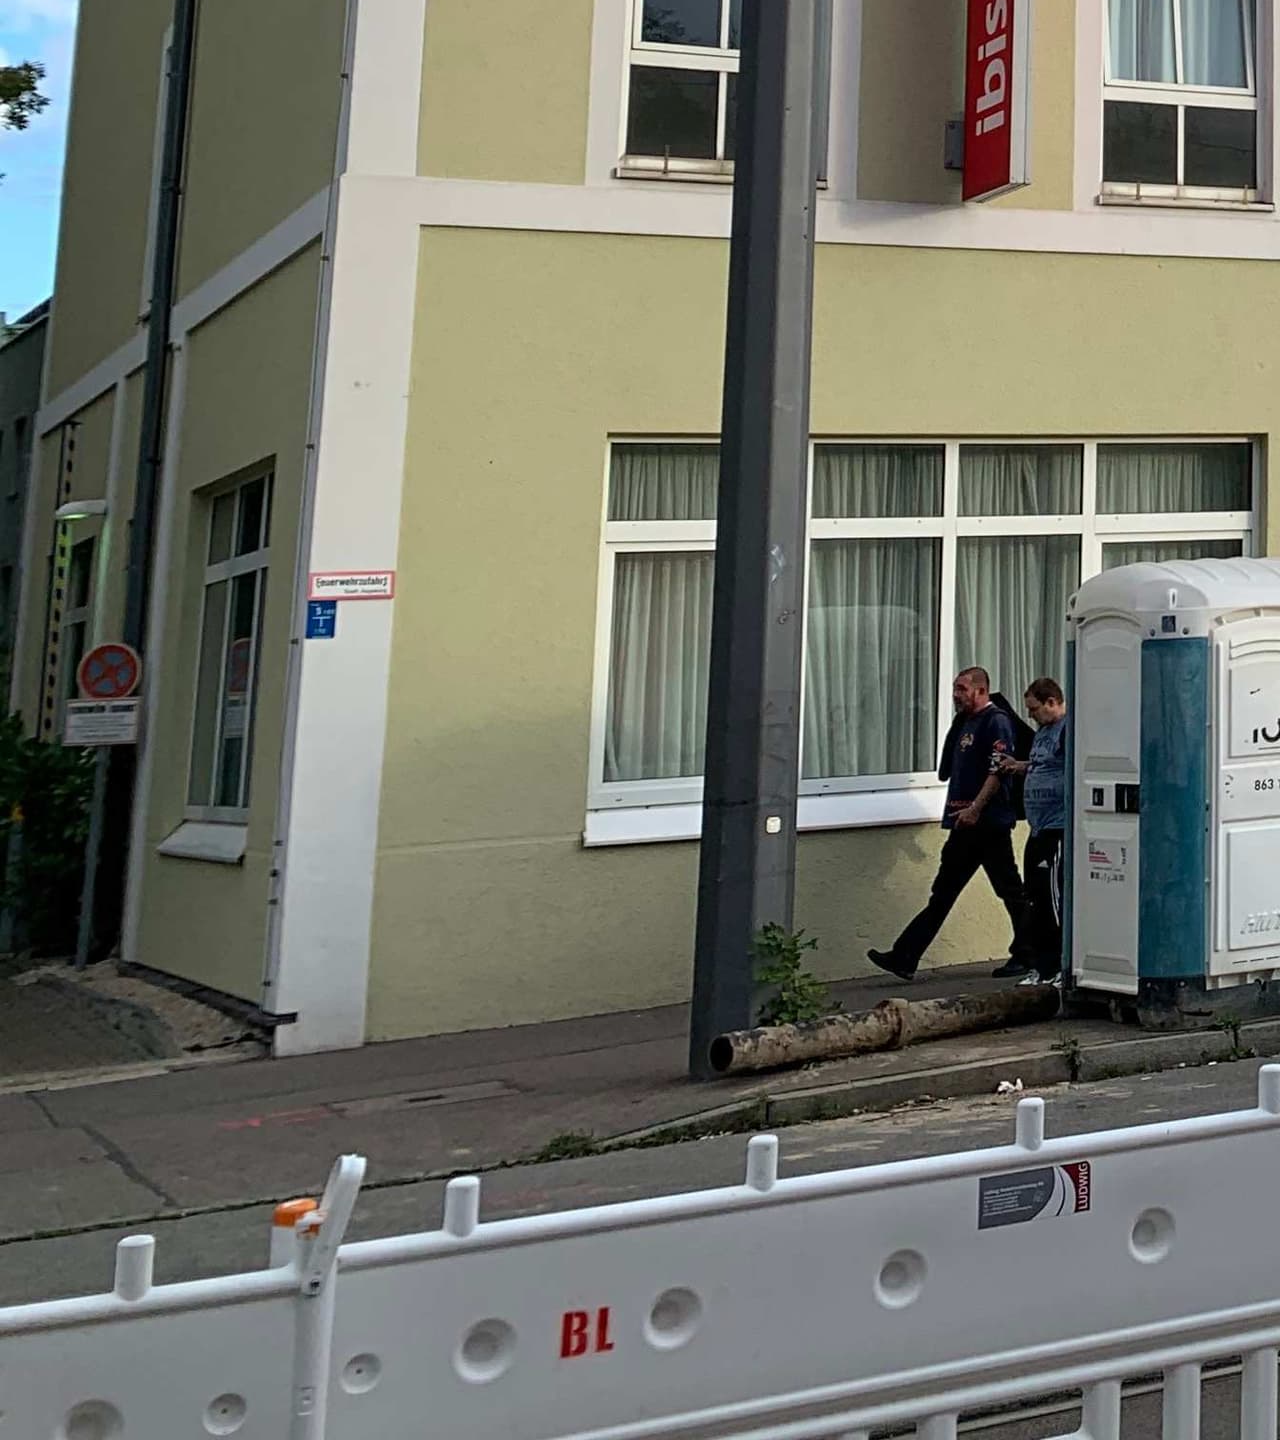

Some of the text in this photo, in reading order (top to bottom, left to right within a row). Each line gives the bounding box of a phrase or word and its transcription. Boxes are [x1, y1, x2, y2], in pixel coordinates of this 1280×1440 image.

[1254, 779, 1274, 791] 863
[1078, 1162, 1089, 1210] LUDWIG
[560, 1306, 615, 1359] BL
